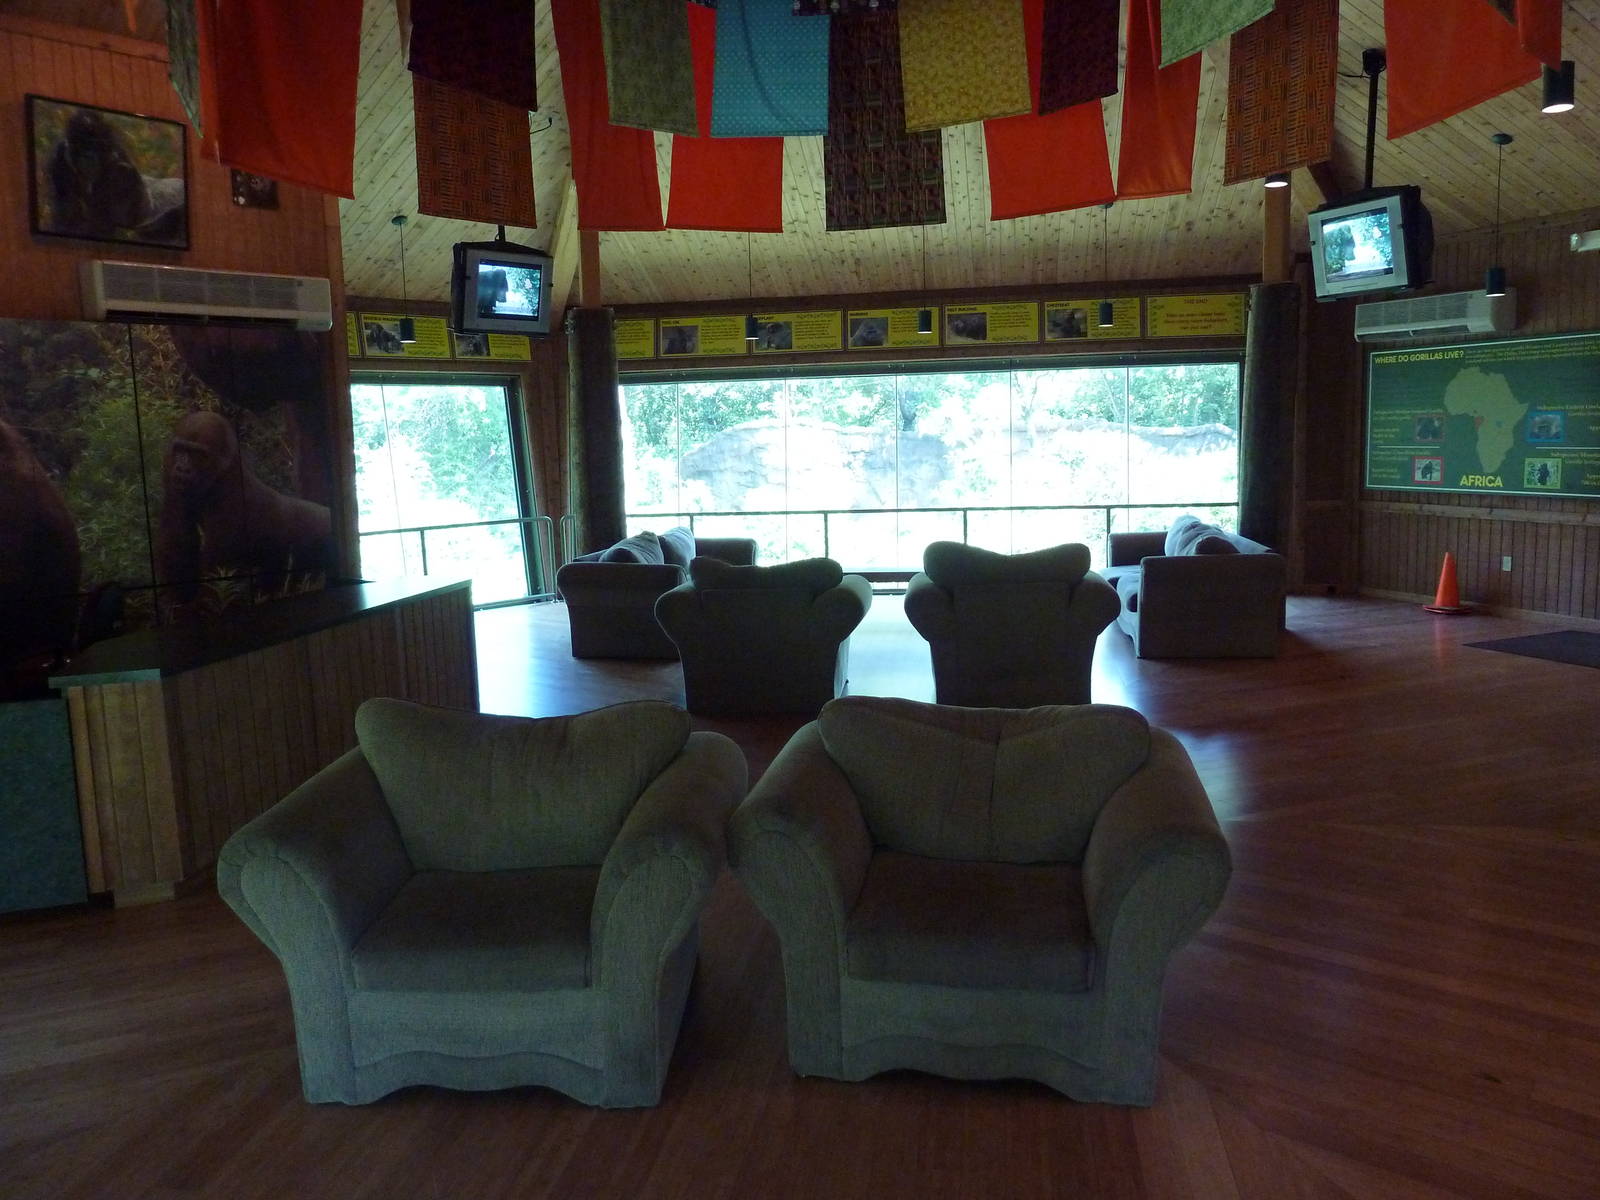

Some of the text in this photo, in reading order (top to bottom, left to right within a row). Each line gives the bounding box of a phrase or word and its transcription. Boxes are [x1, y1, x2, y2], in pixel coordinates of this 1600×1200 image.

[1375, 350, 1464, 364] WHERE DO GORILLAS LIVE?
[1460, 475, 1503, 487] AFRICA
